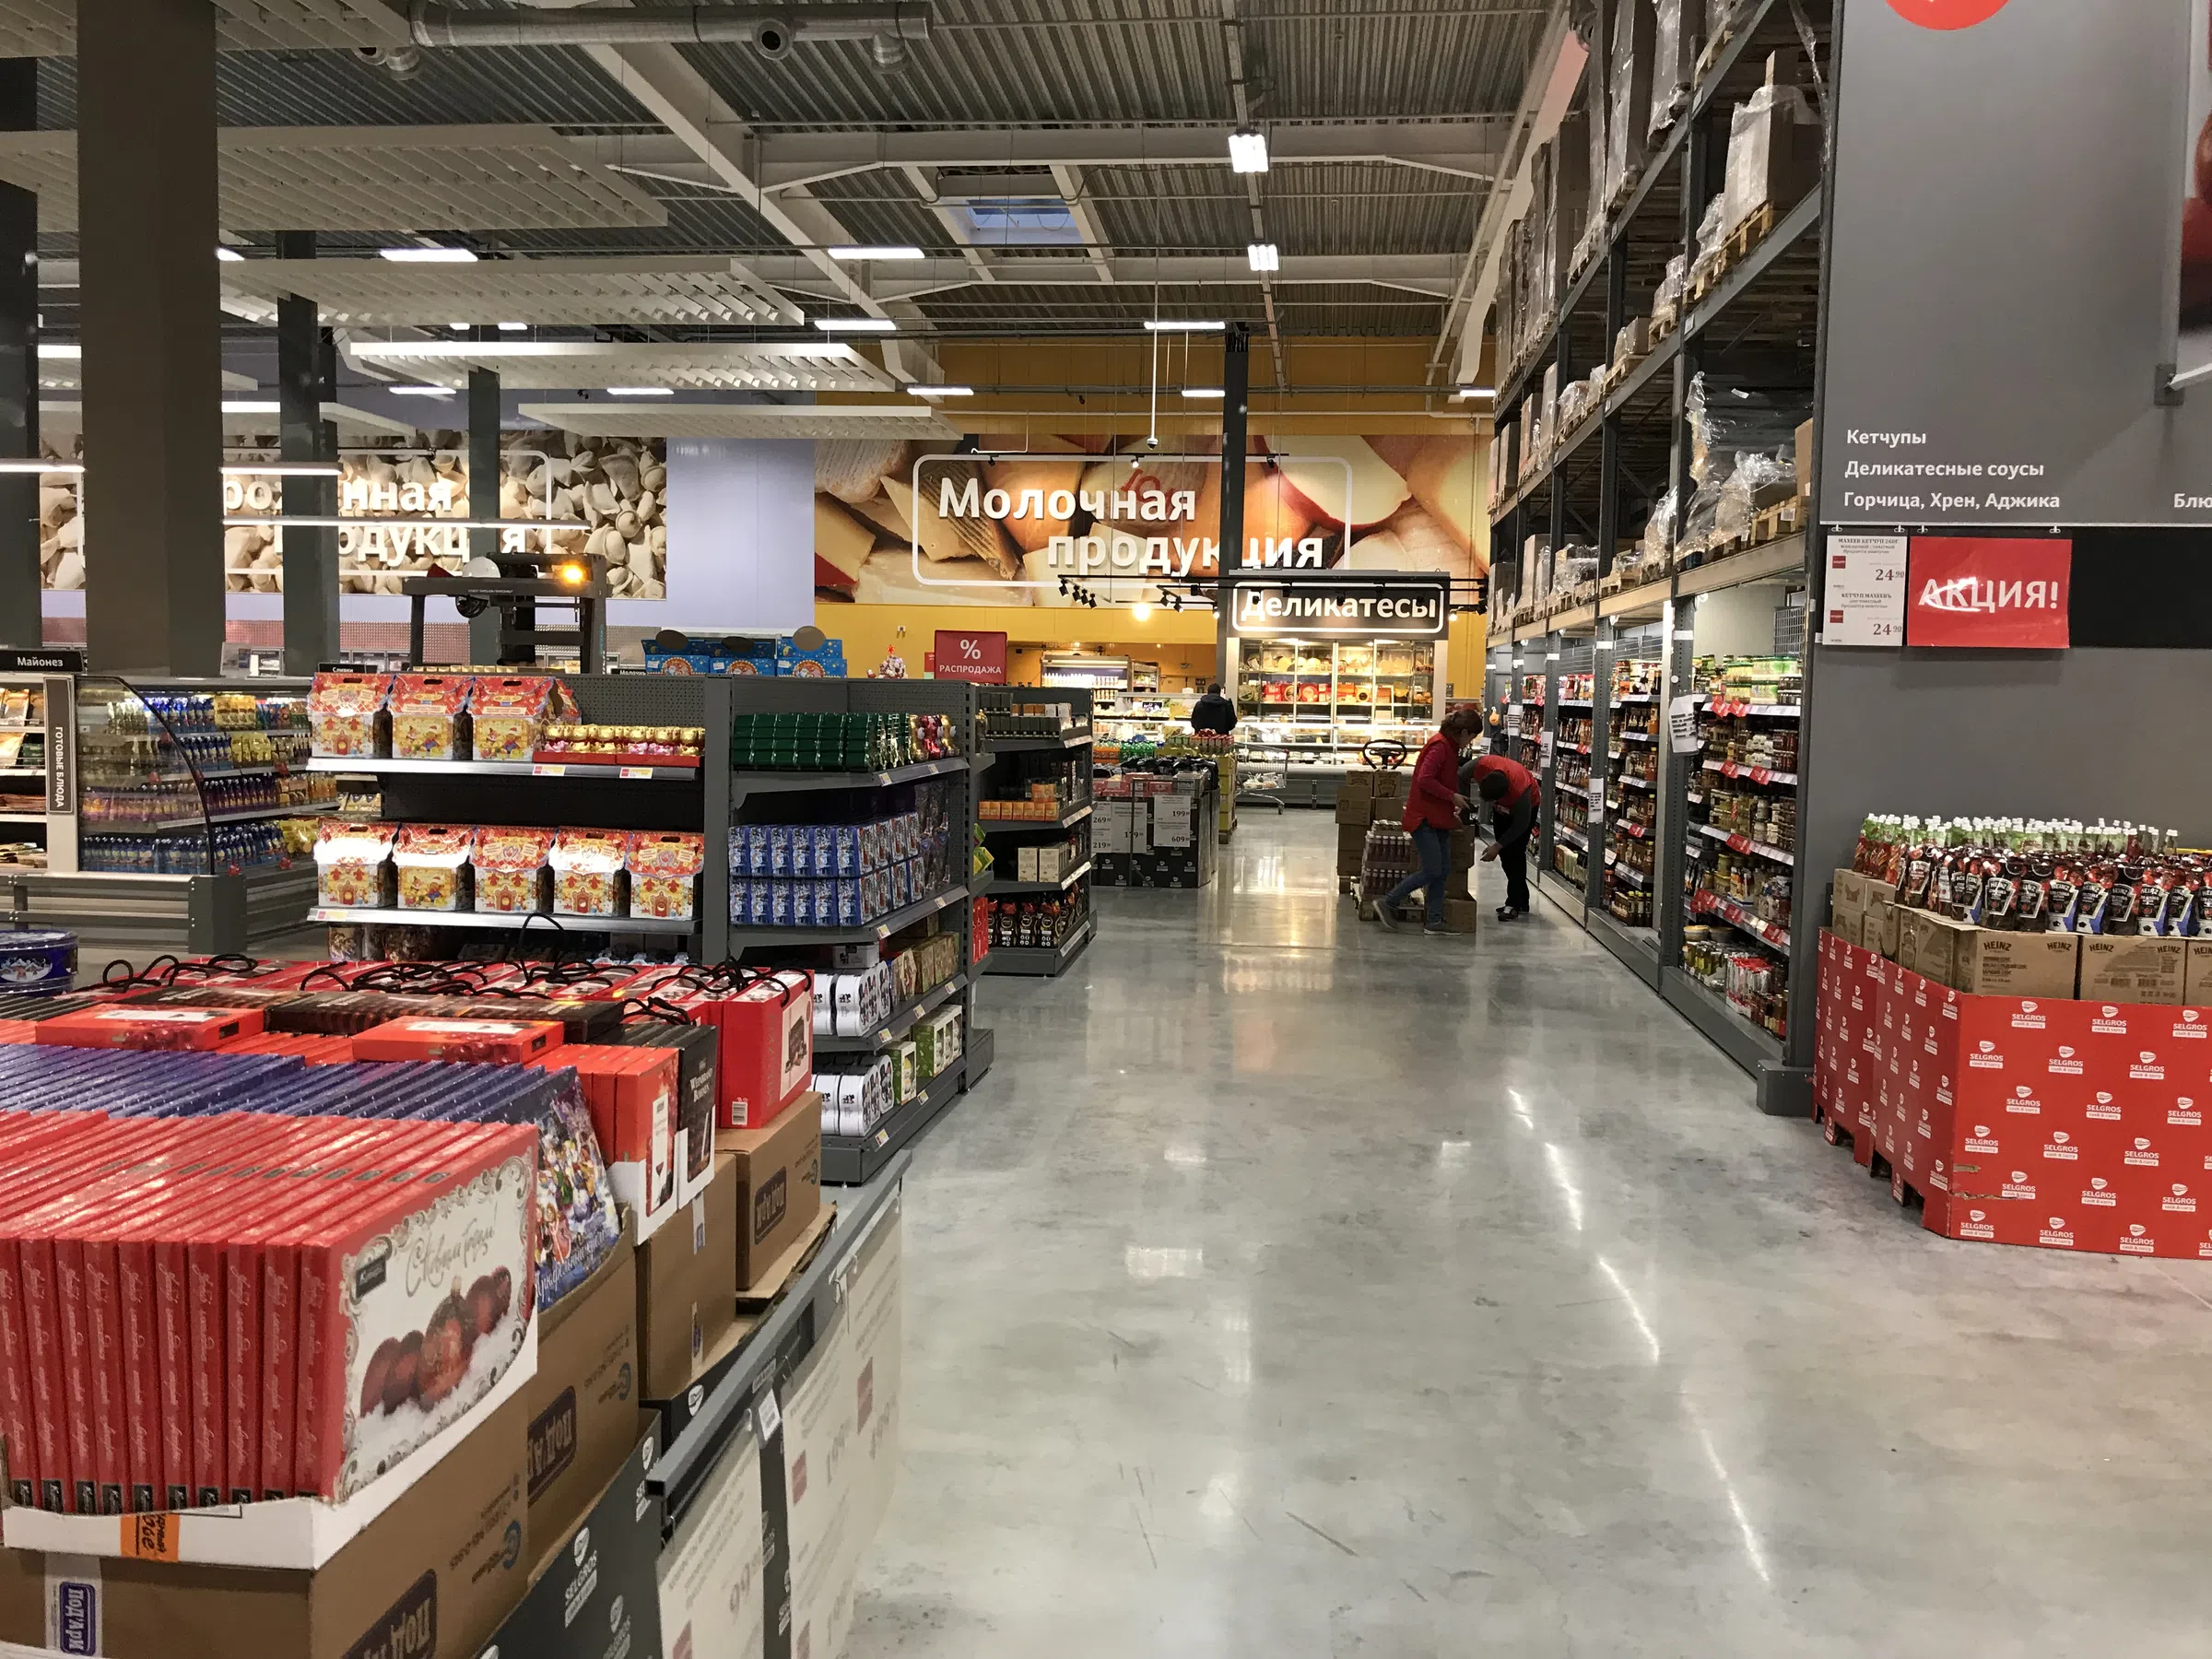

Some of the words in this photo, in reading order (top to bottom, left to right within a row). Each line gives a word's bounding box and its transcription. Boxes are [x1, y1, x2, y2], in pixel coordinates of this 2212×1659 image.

[1846, 429, 1926, 448] Кетчупы
[1844, 461, 1983, 478] Деликатесные
[1987, 465, 2044, 480] соусы
[939, 477, 1195, 521] Молочная
[1844, 491, 1925, 511] Горчица,
[1930, 493, 1981, 512] Хрен,
[1984, 493, 2060, 510] Аджика
[1918, 578, 2058, 614] АКЦИЯ!
[1241, 590, 1436, 622] Деликатесы
[17, 656, 64, 667] Майонез
[939, 665, 1002, 675] РАСПРОДАЖА
[55, 726, 65, 771] ГОТОВЫЕ
[55, 771, 65, 808] БЛЮДА
[1983, 941, 2011, 951] HEINZ
[2047, 941, 2072, 951] HEINZ
[2089, 944, 2114, 953] HEINZ
[2157, 945, 2181, 954] HEINZ
[2194, 947, 2212, 955] HEIN
[2087, 1104, 2121, 1112] SELGROS
[2002, 1183, 2036, 1192] SELGROS
[1960, 1222, 1994, 1230] SELGROS
[2040, 1230, 2074, 1238] SELGROS
